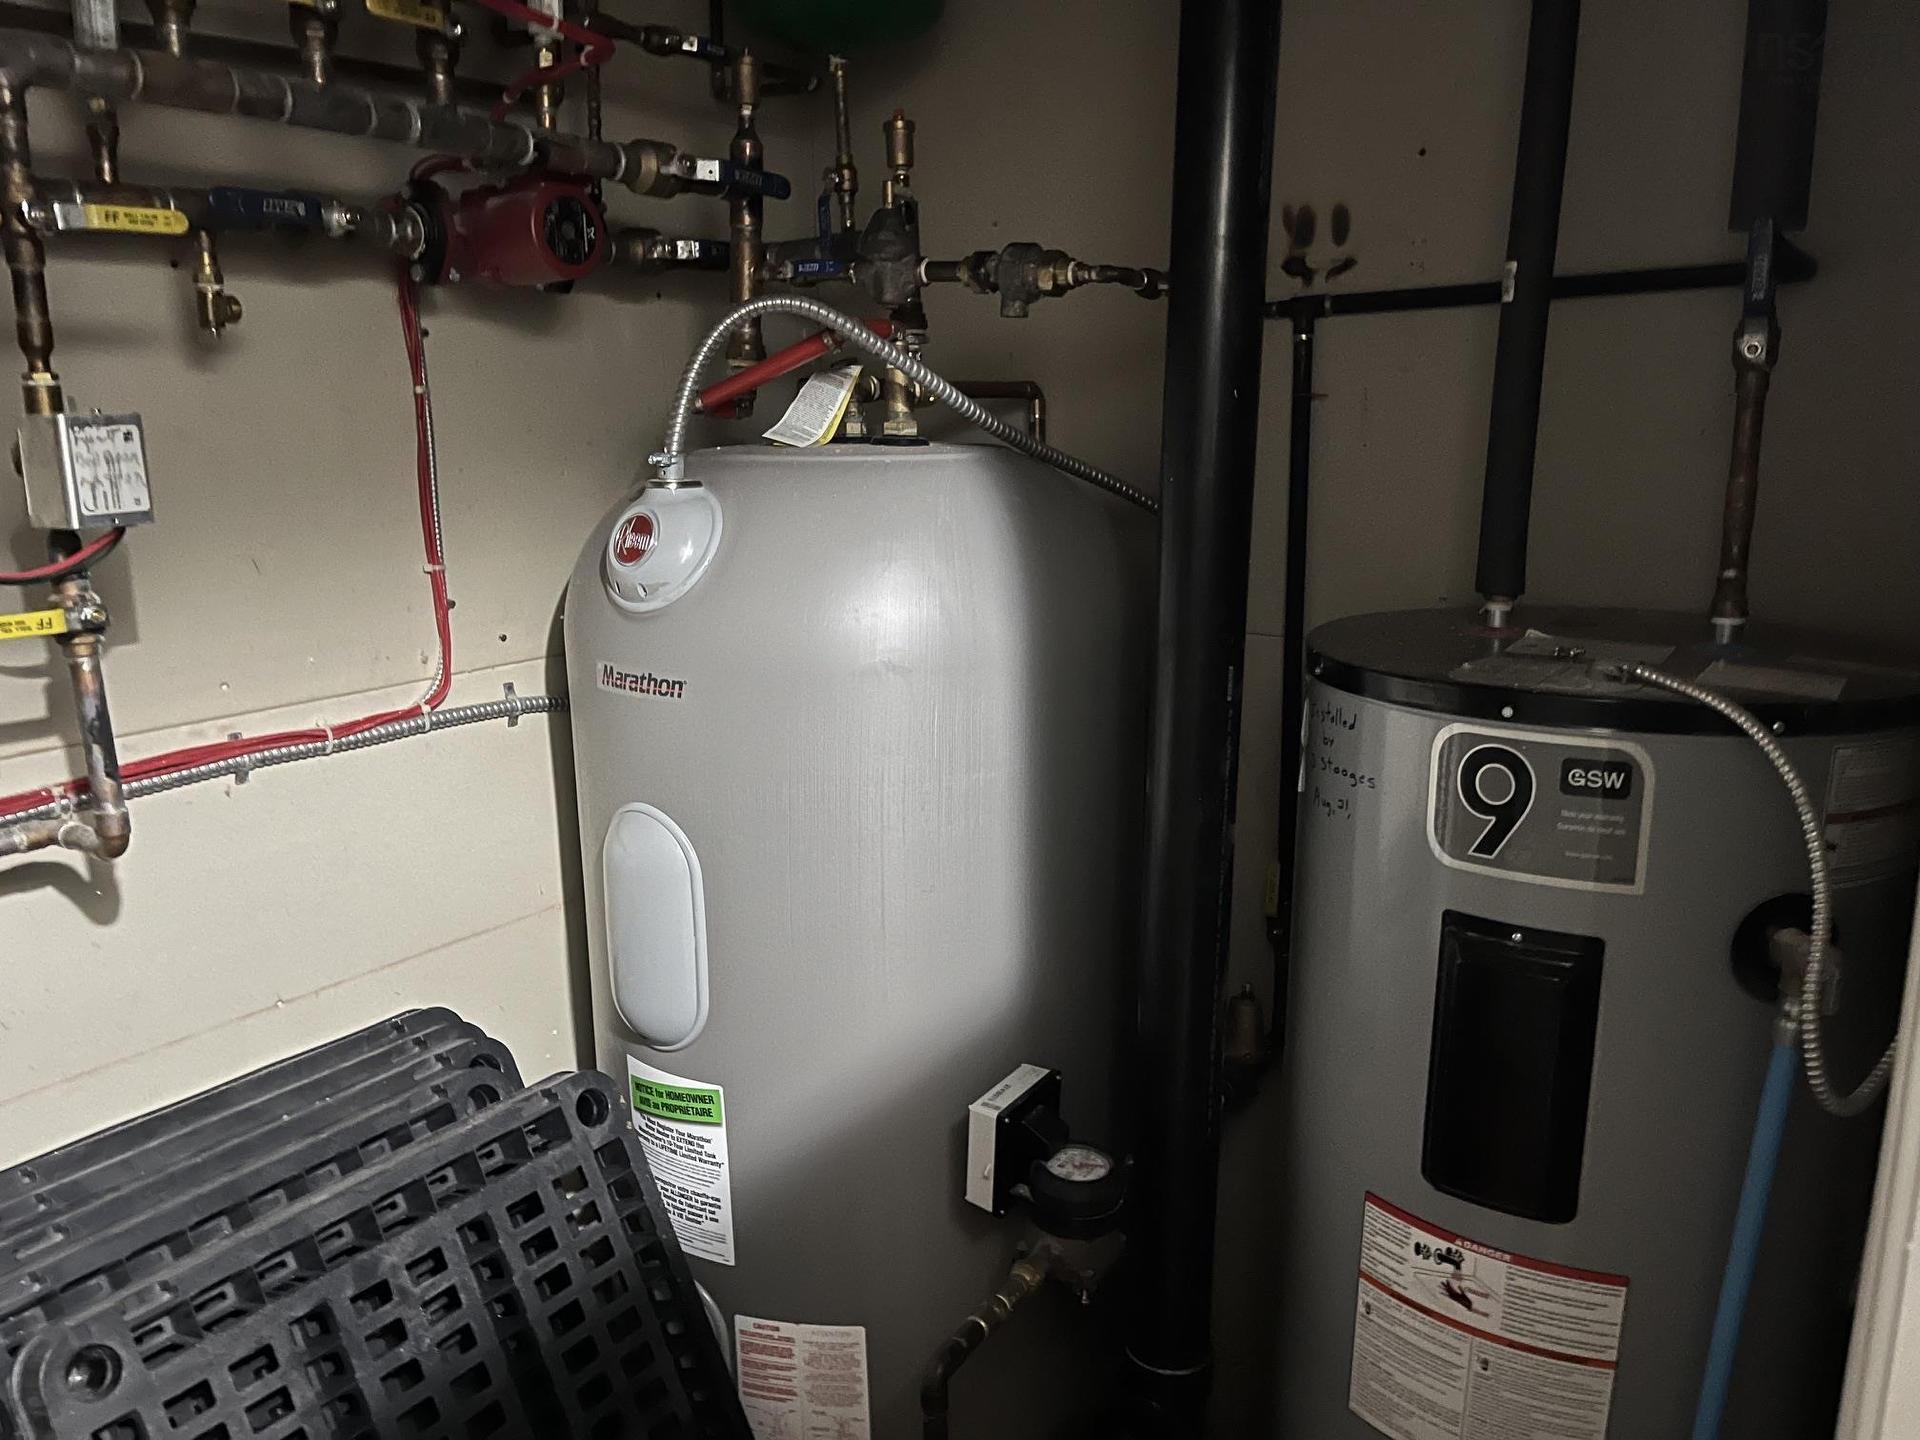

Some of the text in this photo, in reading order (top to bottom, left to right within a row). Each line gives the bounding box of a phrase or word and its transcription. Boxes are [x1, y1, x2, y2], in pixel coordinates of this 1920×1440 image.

[616, 518, 651, 556] Rheem
[602, 663, 685, 699] Marathon
[1567, 768, 1626, 791] GSW
[1457, 743, 1537, 860] 9
[635, 1082, 714, 1104] NOTICE for HOMEOWNER
[1463, 1241, 1511, 1262] DANGER
